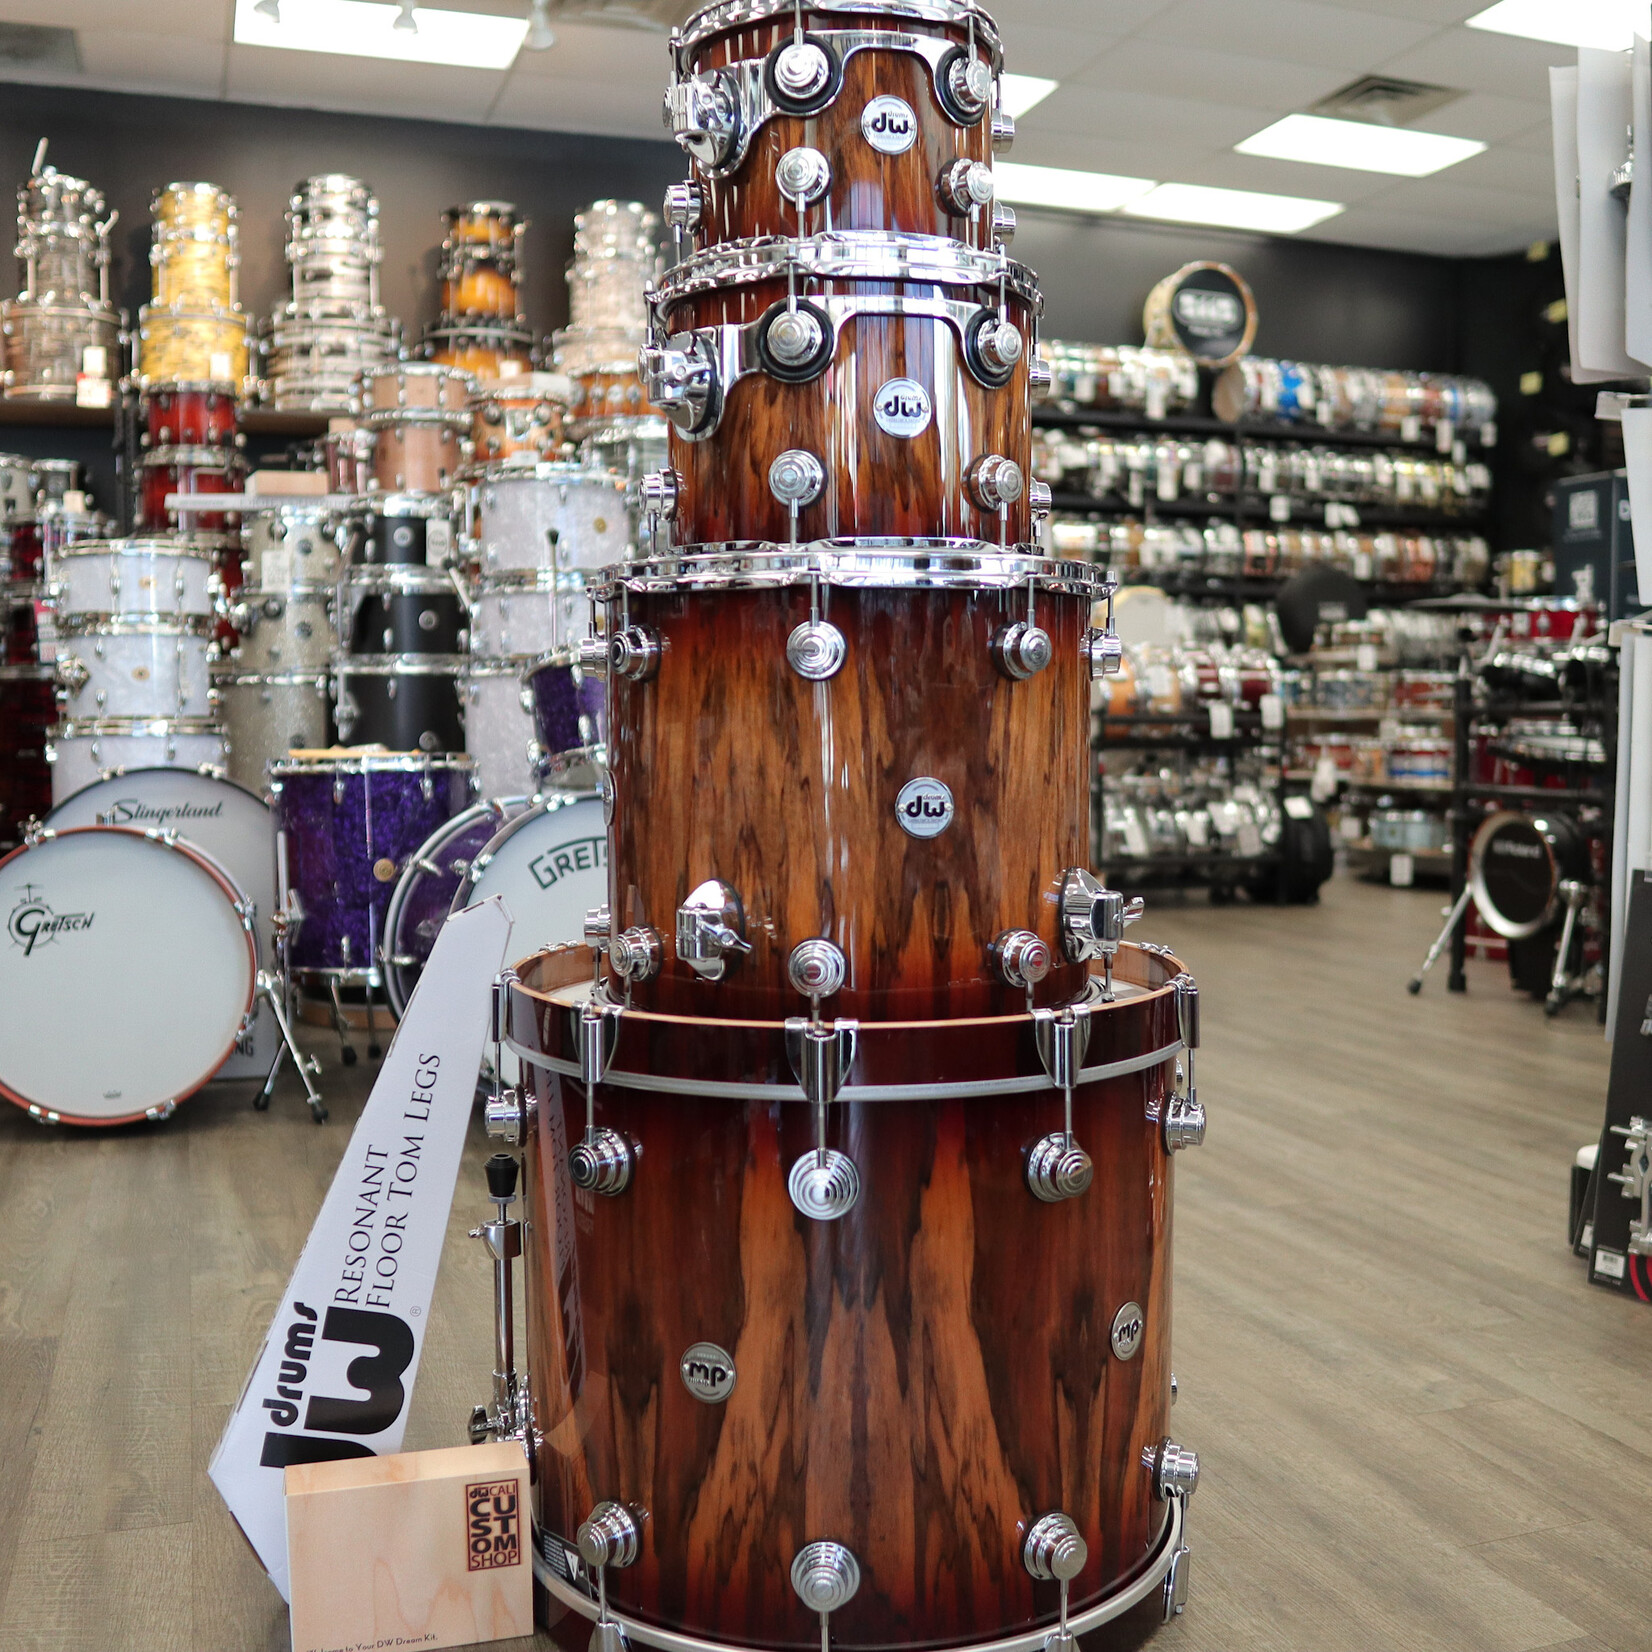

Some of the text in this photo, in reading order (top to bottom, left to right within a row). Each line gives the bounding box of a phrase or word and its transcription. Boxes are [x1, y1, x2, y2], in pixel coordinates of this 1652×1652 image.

[871, 112, 909, 134] dw
[884, 395, 922, 418] dw
[112, 798, 223, 825] Slingerland
[906, 795, 945, 818] dw
[234, 1036, 255, 1058] NG
[365, 1053, 441, 1308] FLOOR TOM LEGS
[333, 1144, 388, 1305] RESONANT
[262, 1301, 318, 1427] drums
[489, 1483, 516, 1497] CALI
[471, 1550, 518, 1569] SHOP
[355, 1643, 375, 1651] Your
[377, 1639, 394, 1648] DW
[396, 1637, 423, 1646] Dream
